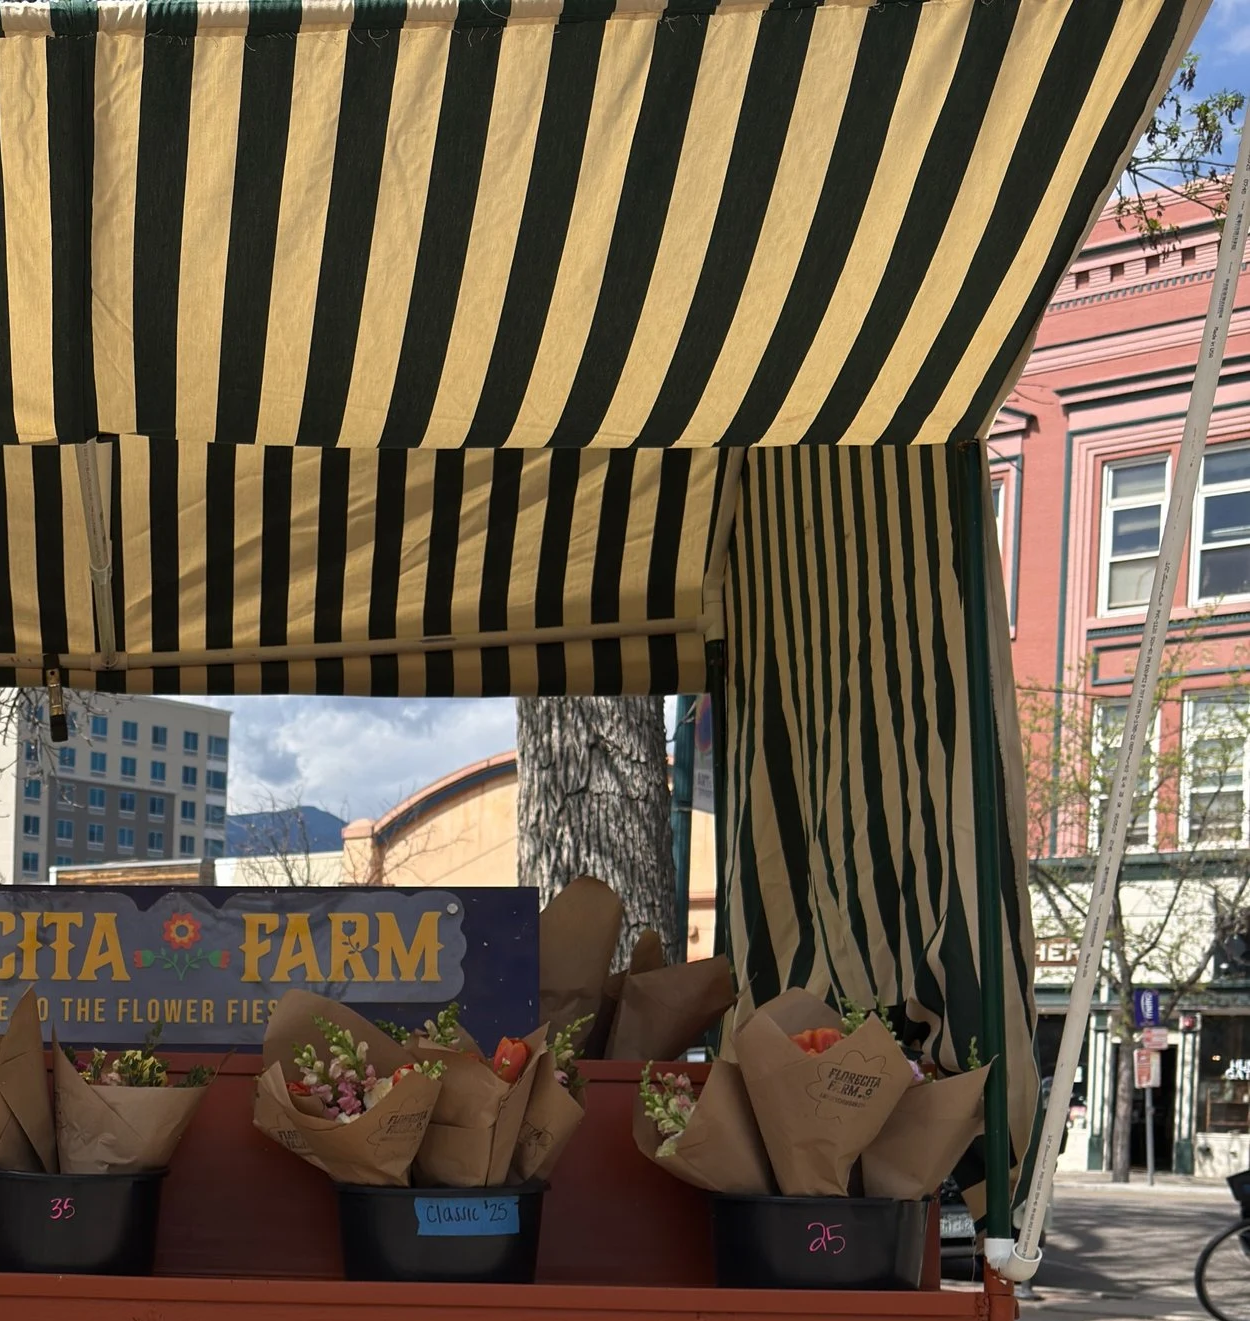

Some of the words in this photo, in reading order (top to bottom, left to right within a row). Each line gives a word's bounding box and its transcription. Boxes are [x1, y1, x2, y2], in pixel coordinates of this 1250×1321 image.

[240, 912, 444, 982] FARM
[37, 997, 49, 1021] O
[61, 998, 106, 1022] THE
[118, 999, 214, 1023] FLOWER
[827, 1080, 860, 1097] FRM
[829, 1067, 881, 1088] FLORECITA
[50, 1198, 75, 1220] 35
[426, 1204, 481, 1224] Classic
[807, 1223, 846, 1254] 25
